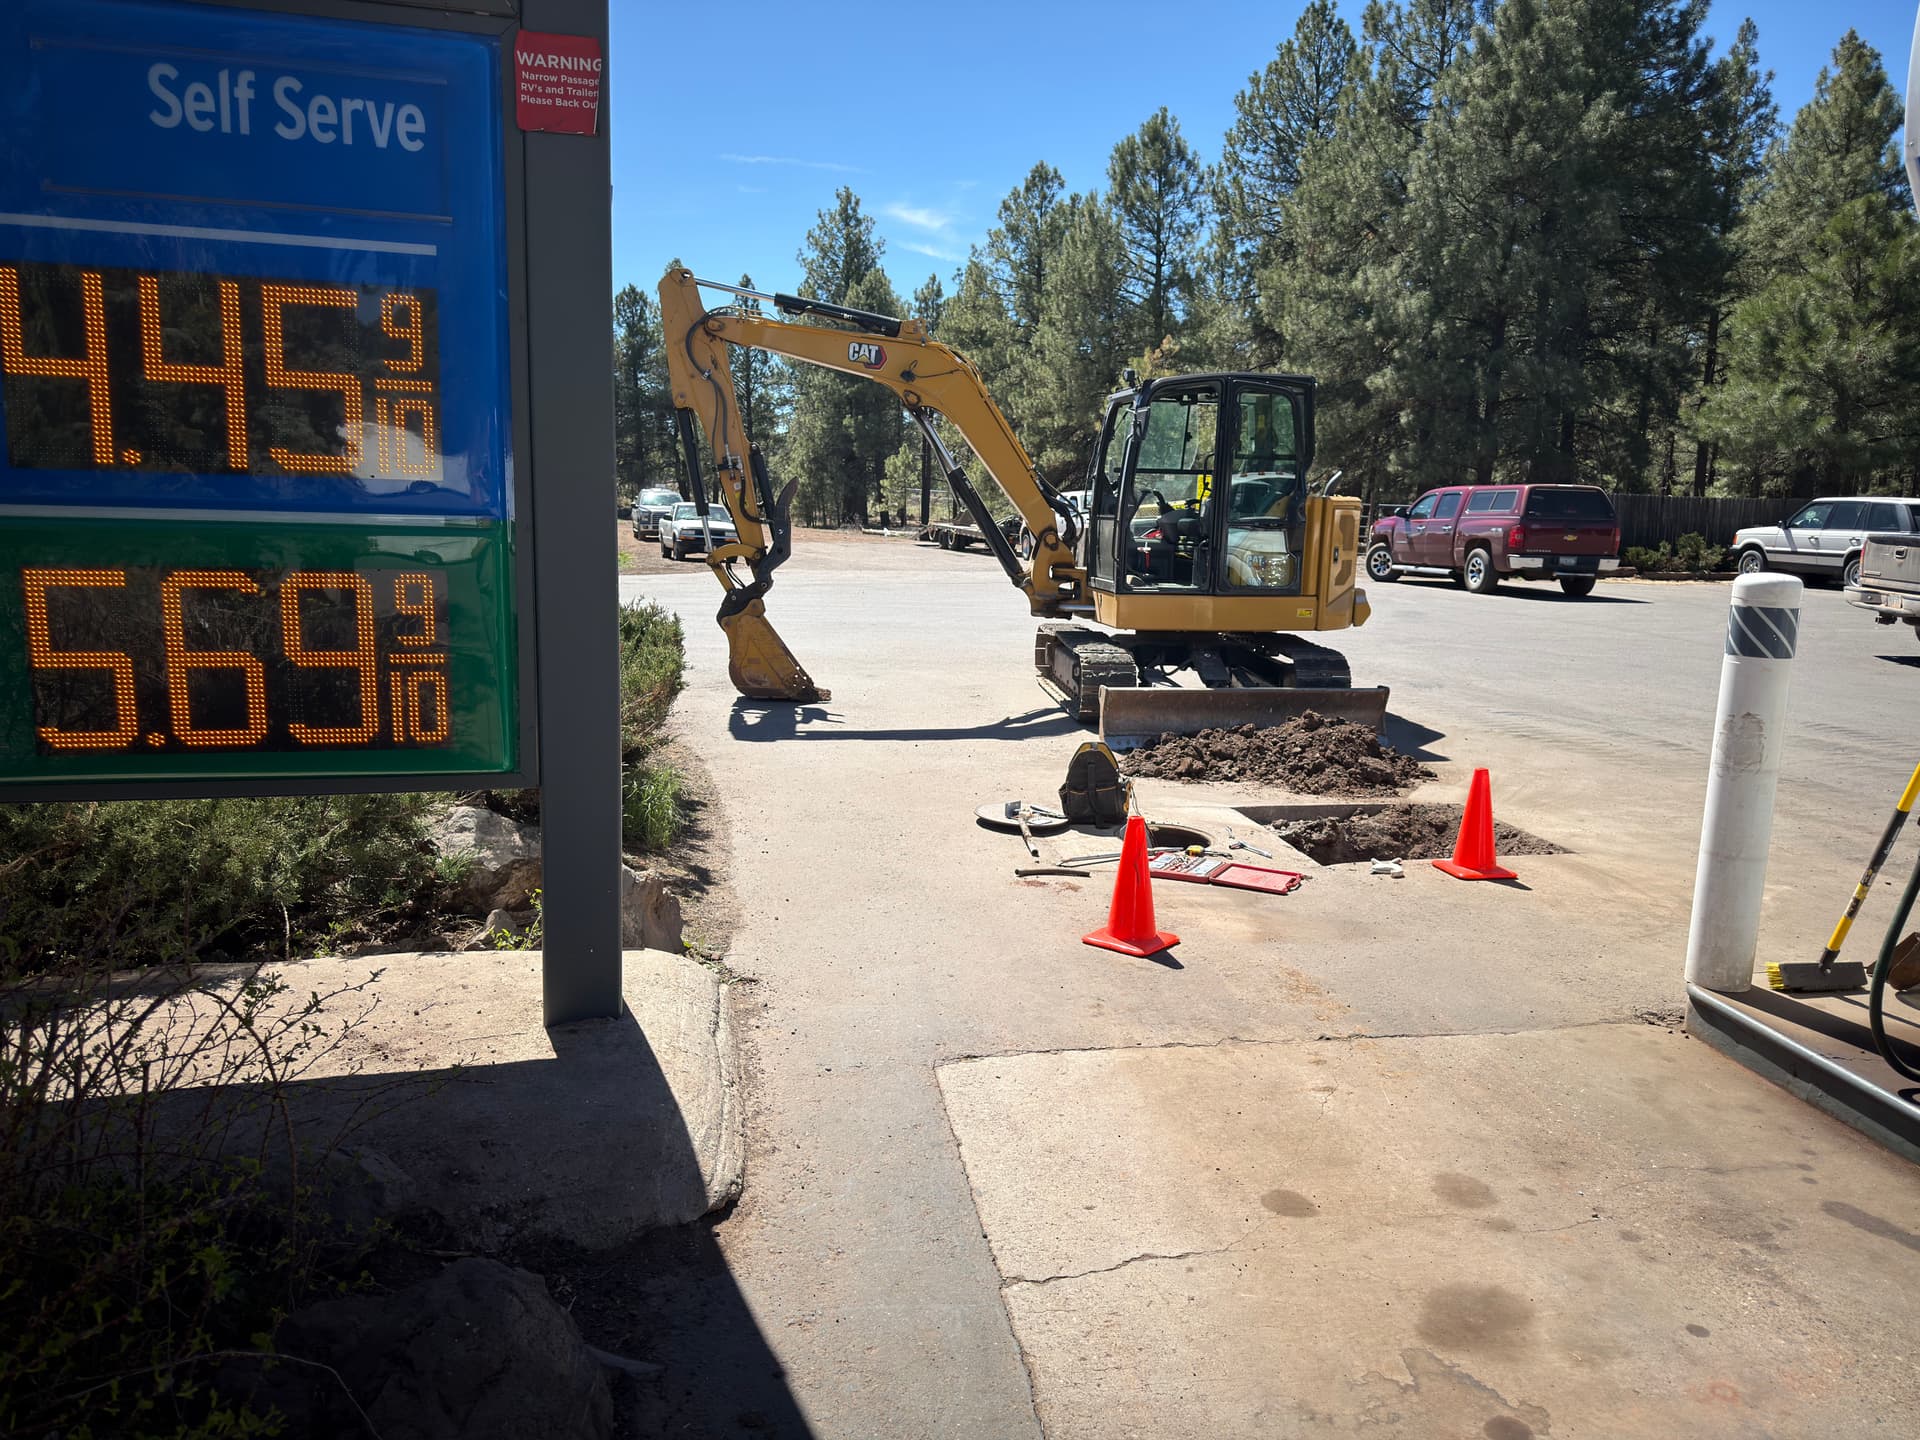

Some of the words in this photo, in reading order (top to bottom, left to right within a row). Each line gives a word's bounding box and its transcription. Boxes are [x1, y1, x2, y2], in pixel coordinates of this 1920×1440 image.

[517, 50, 602, 72] WARNING
[521, 82, 543, 93] RV's
[545, 86, 564, 95] and
[522, 71, 558, 82] Narrow
[561, 75, 600, 87] Passage
[148, 63, 255, 135] Self
[273, 76, 426, 152] Serve
[521, 94, 553, 106] Please
[555, 98, 580, 108] Back
[848, 341, 879, 364] CAT
[0, 266, 363, 473] 4.45
[21, 568, 380, 749] 5.69
